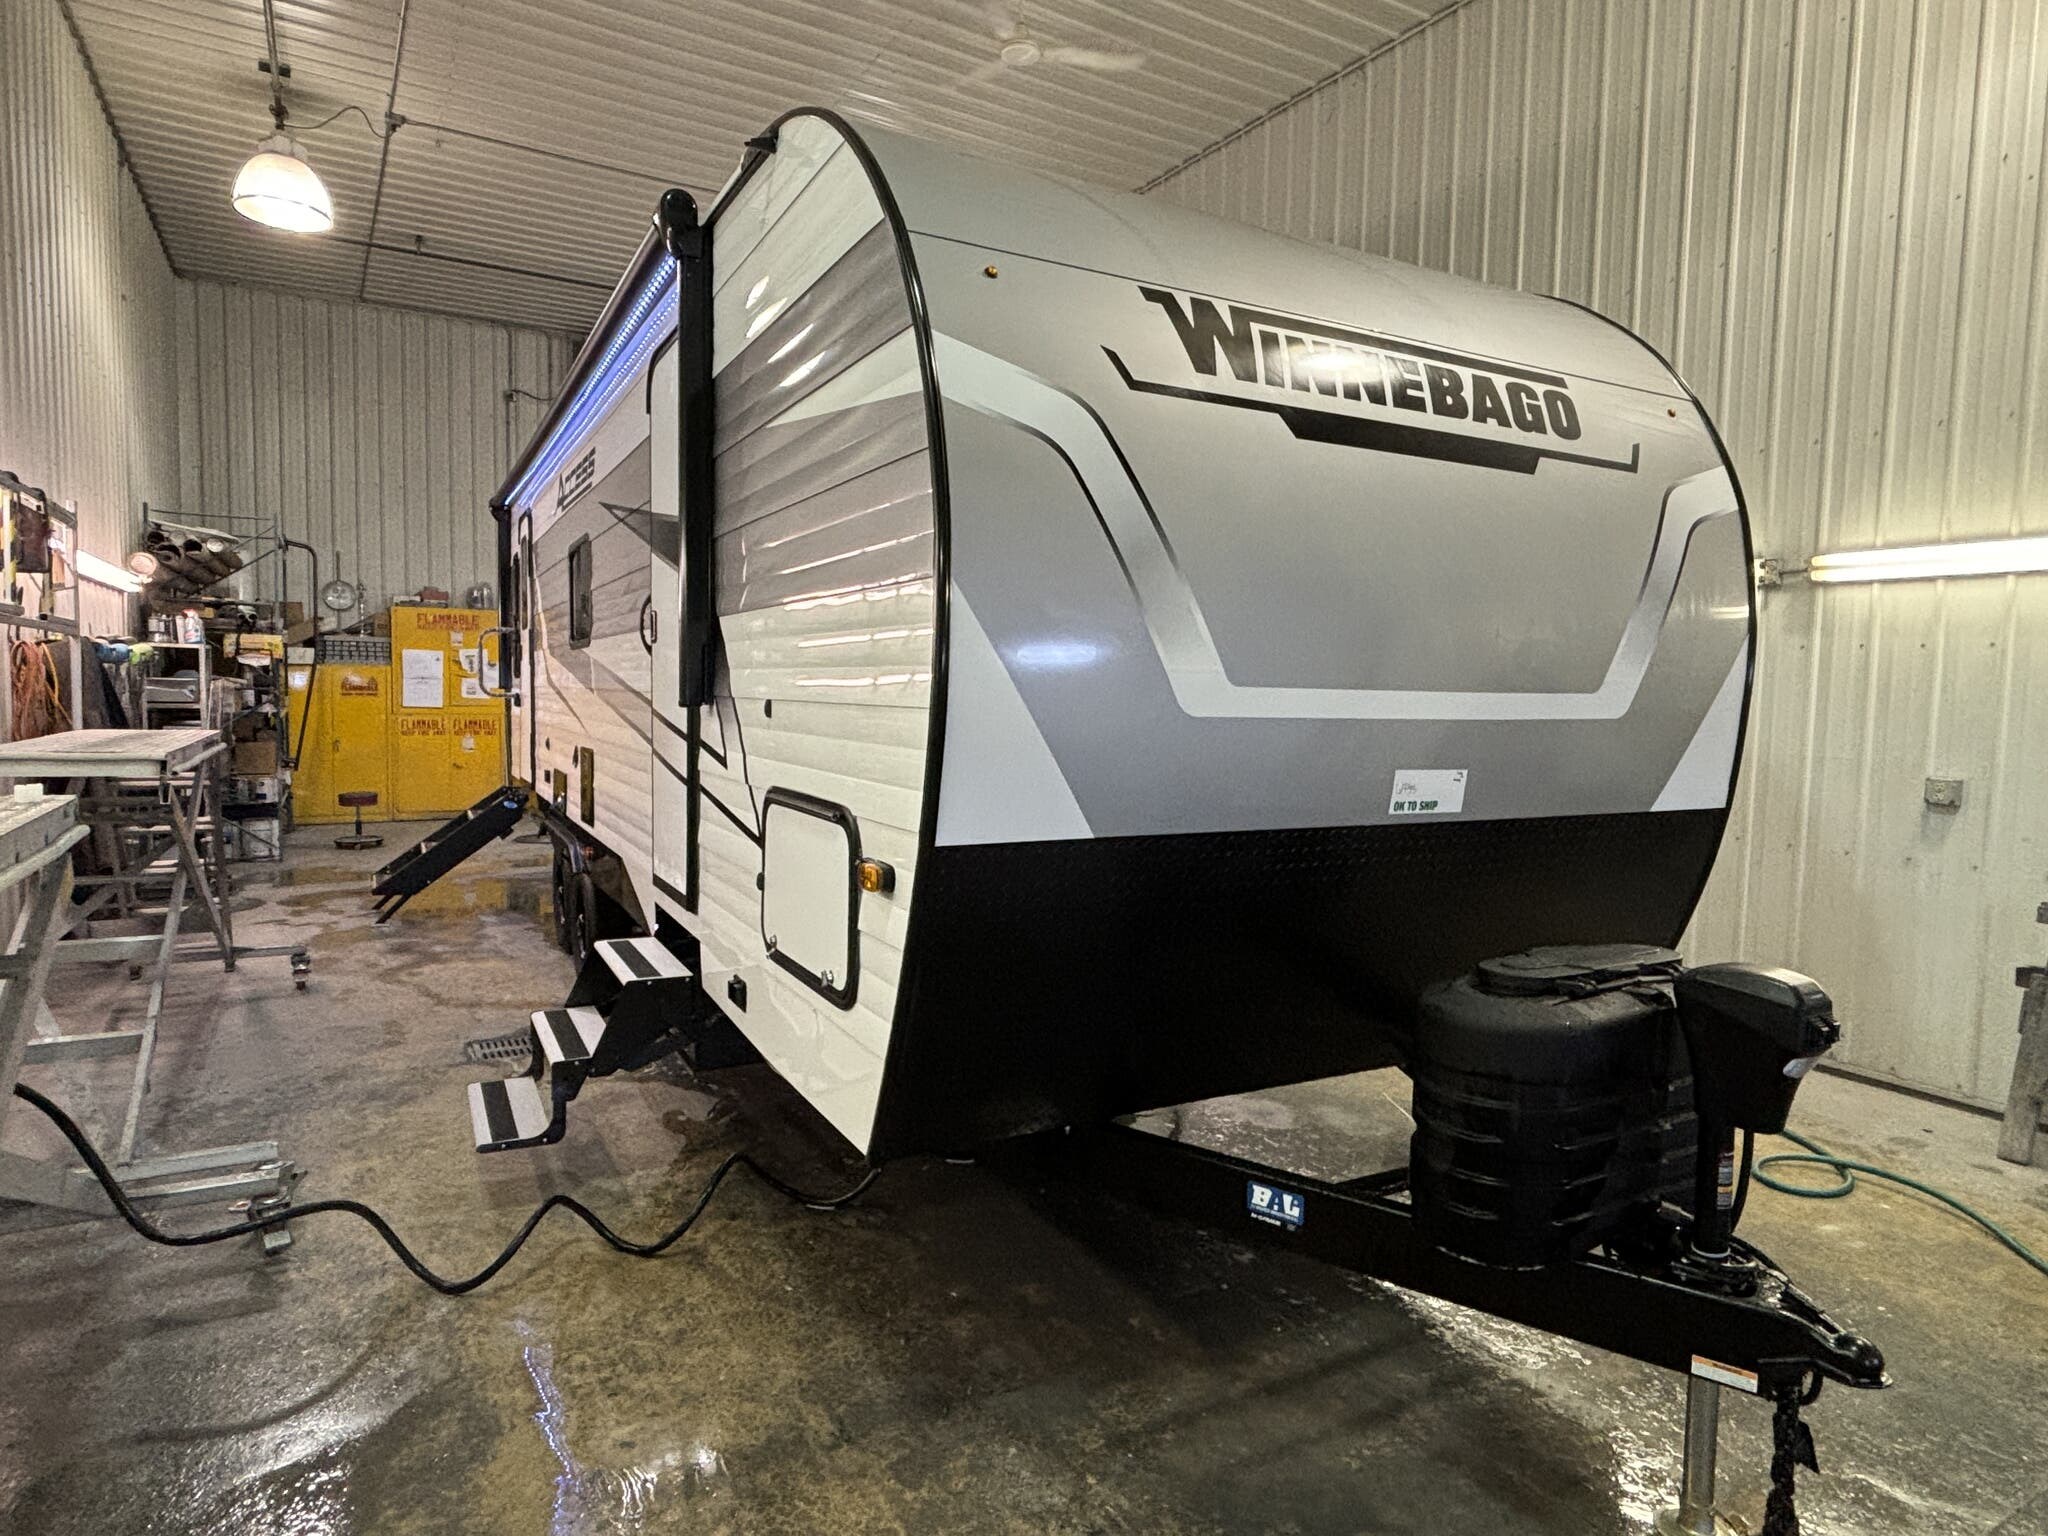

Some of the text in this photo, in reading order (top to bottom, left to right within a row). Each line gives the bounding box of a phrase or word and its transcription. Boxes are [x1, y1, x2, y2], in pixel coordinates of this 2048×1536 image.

[1138, 285, 1582, 441] WINNEBAGO
[417, 613, 479, 625] FLAMMABLE
[401, 718, 445, 729] FLAMMABLE
[453, 719, 496, 729] FLAMMABLE
[1393, 800, 1438, 812] OK TO SHIP
